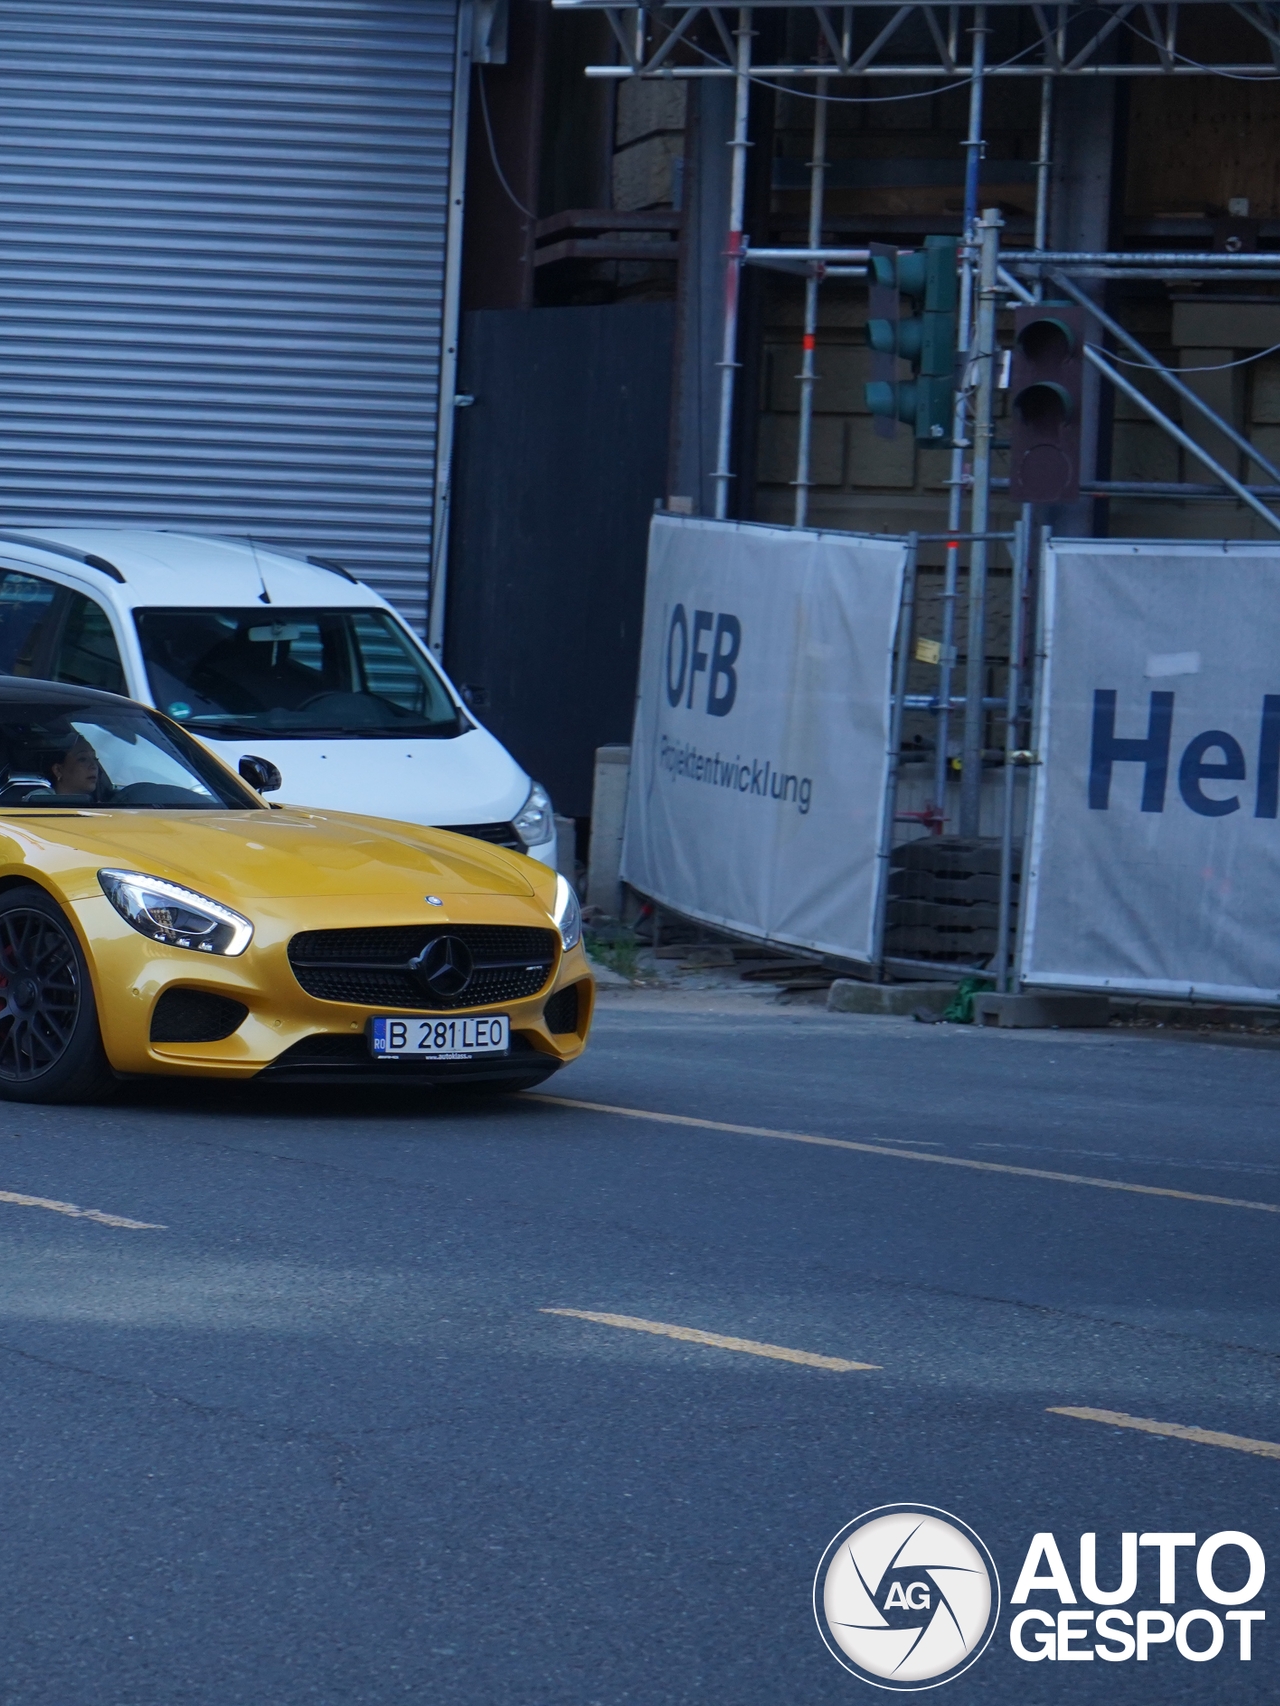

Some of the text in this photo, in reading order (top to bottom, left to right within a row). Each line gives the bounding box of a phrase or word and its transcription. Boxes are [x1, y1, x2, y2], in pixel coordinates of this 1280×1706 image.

[666, 603, 742, 718] OFB
[374, 1038, 385, 1050] RO
[389, 1019, 503, 1049] B 281 LEO
